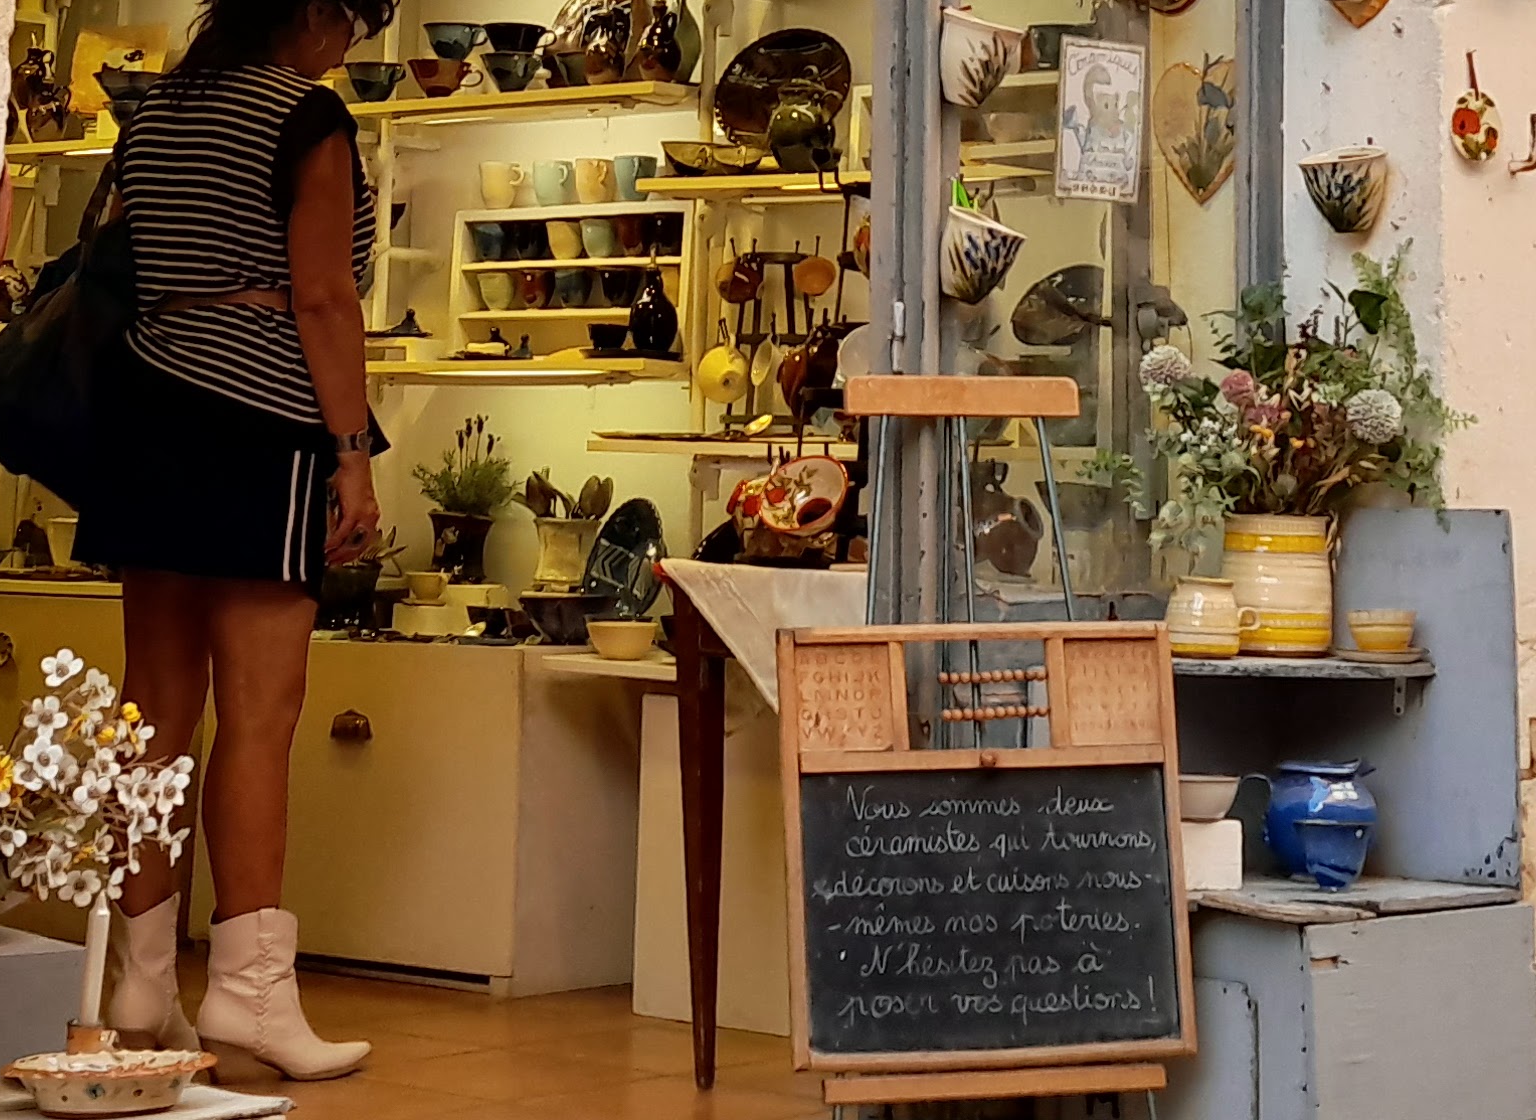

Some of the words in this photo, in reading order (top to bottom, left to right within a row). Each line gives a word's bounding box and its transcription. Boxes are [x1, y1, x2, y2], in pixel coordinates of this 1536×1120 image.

[919, 797, 1021, 818] sommes
[1038, 785, 1114, 816] deux
[845, 820, 980, 857] céramistes
[989, 825, 1029, 858] qui
[1040, 822, 1157, 853] tournons,
[826, 868, 945, 899] décorons
[950, 866, 981, 893] et
[986, 866, 1069, 893] cuisons
[945, 914, 998, 933] nos
[860, 942, 998, 990] N'hésitez
[1005, 955, 1061, 982] pas
[1072, 941, 1104, 973] à
[838, 995, 939, 1028] poser
[951, 994, 1003, 1014] vos
